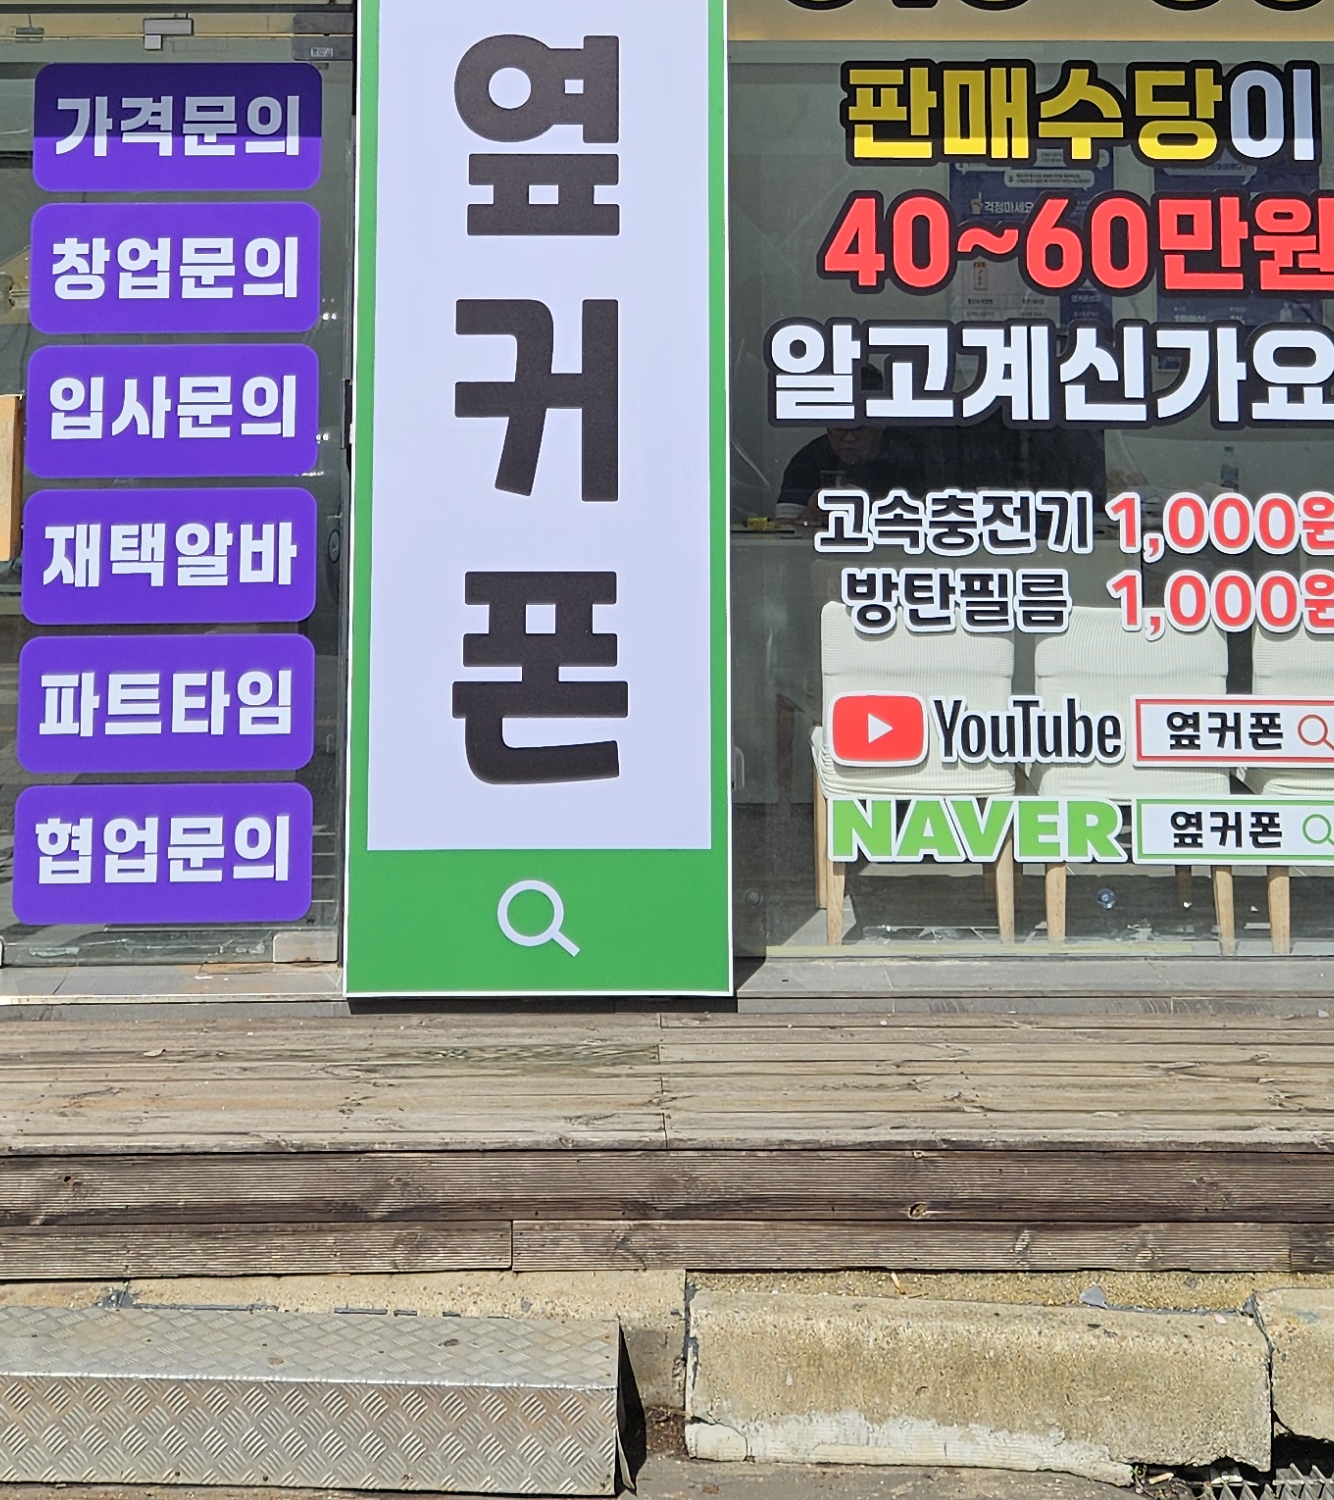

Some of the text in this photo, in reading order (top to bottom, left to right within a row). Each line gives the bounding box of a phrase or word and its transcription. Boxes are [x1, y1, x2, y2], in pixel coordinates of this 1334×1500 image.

[55, 95, 300, 157] 가격문의
[847, 67, 1315, 161] 판매수당이
[51, 236, 299, 299] 창업문의
[48, 374, 297, 439] 입사문의
[452, 34, 628, 785] 옆커폰
[820, 493, 1091, 551] 고속충전기
[43, 521, 297, 588] 재택알바
[845, 571, 1069, 630] 방탄필름
[38, 668, 293, 737] 파트타임
[933, 698, 1284, 762] YouTube 옆커폰
[35, 814, 290, 886] 협업문의
[831, 800, 1283, 863] NAVER 옆커폰
